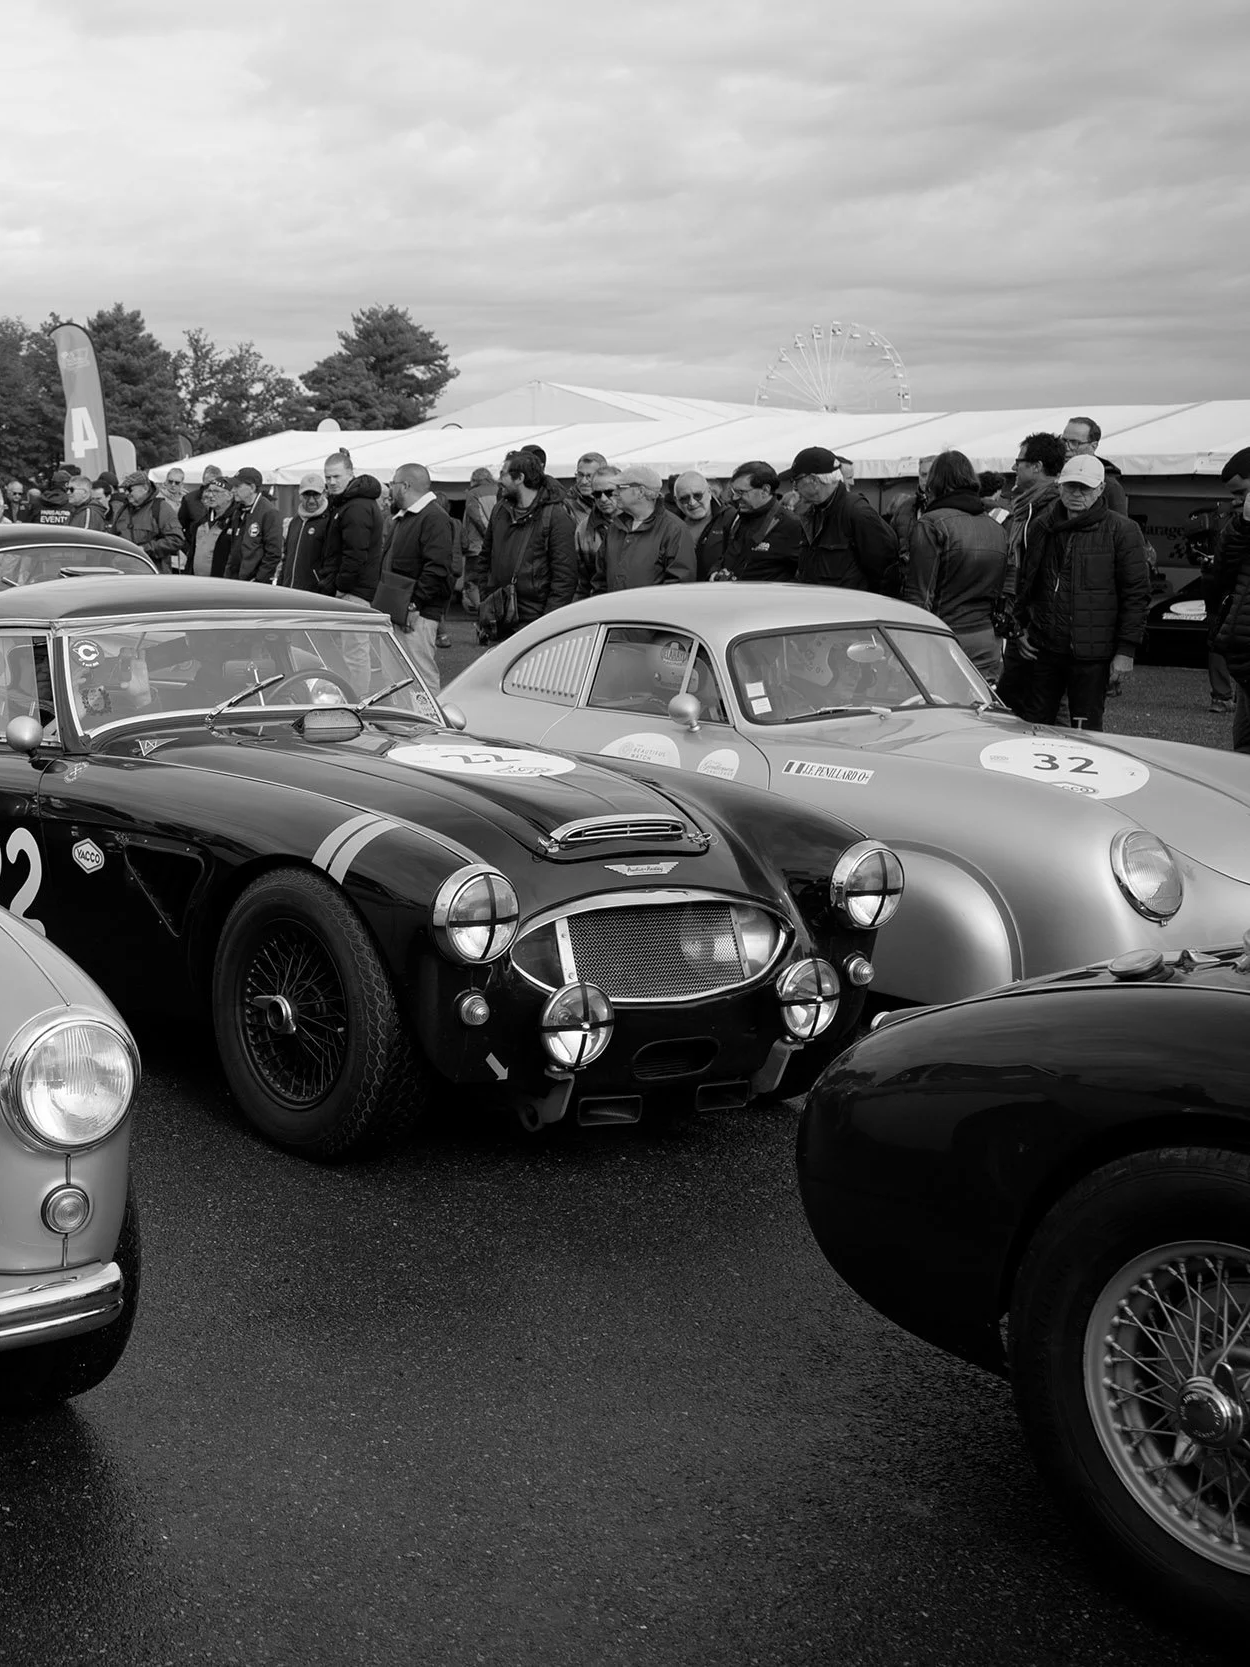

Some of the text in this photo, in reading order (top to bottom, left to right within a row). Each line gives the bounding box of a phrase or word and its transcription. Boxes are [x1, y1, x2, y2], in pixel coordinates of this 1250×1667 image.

[630, 753, 652, 761] WATCH
[633, 748, 667, 758] BEAUTIFUL
[1032, 753, 1099, 775] 32
[814, 766, 859, 780] PENILLARD
[76, 848, 101, 864] YACCO
